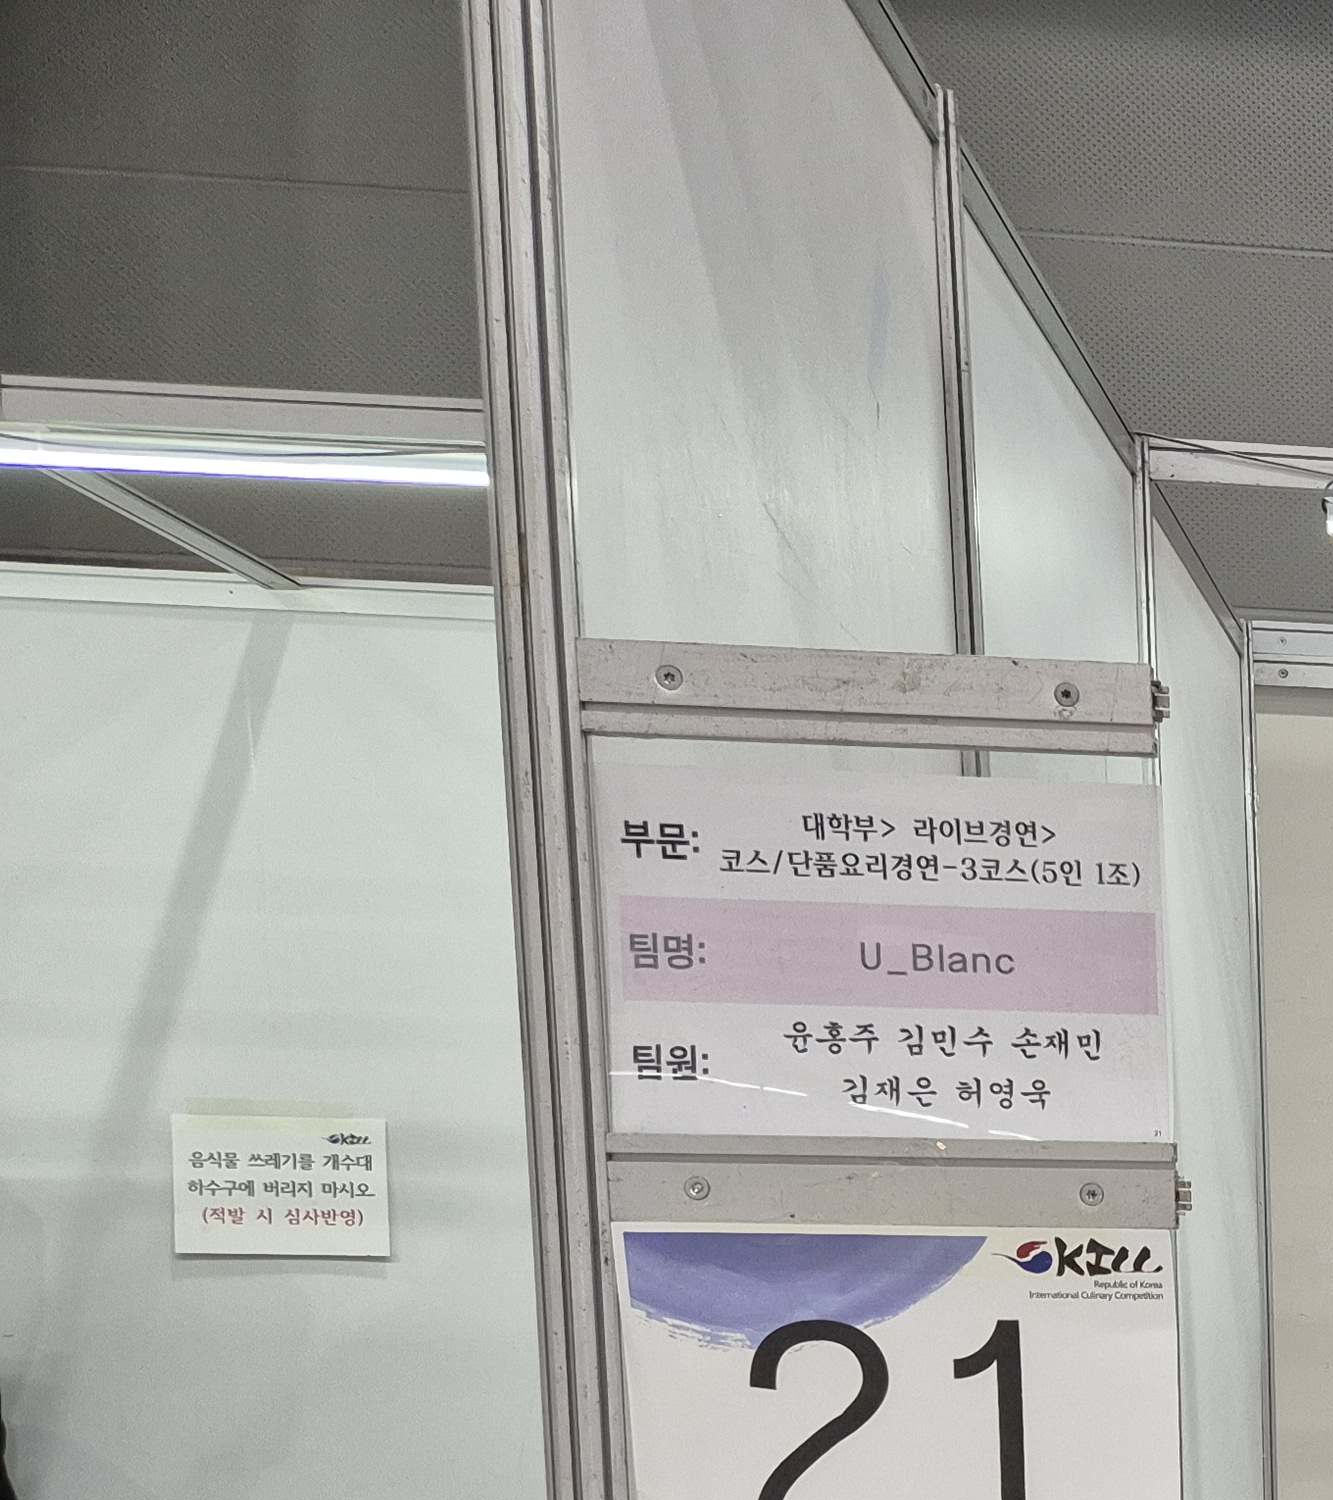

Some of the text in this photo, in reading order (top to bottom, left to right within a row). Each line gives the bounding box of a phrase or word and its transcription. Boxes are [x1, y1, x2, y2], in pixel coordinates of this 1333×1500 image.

[620, 820, 700, 861] 부문:
[801, 812, 1057, 849] 대학부> 라이브경연>
[719, 848, 1142, 889] 코스/단품요리경연-3코스(5인 1조)
[628, 931, 706, 971] 팀명:
[859, 941, 1016, 976] U_Blanc
[783, 1021, 1103, 1062] 윤홍주 김민수 손재민
[631, 1043, 710, 1081] 팀원:
[842, 1076, 1052, 1111] 김재은 허영욱
[188, 1151, 373, 1172] 음식물 쓰레기를 개수대
[188, 1179, 256, 1197] 하수구에
[263, 1180, 313, 1198] 버리지
[202, 1207, 364, 1227] (적발 시 심사반영)
[1029, 1291, 1163, 1301] International Culinary Competition
[1094, 1280, 1163, 1290] Republic of Korea
